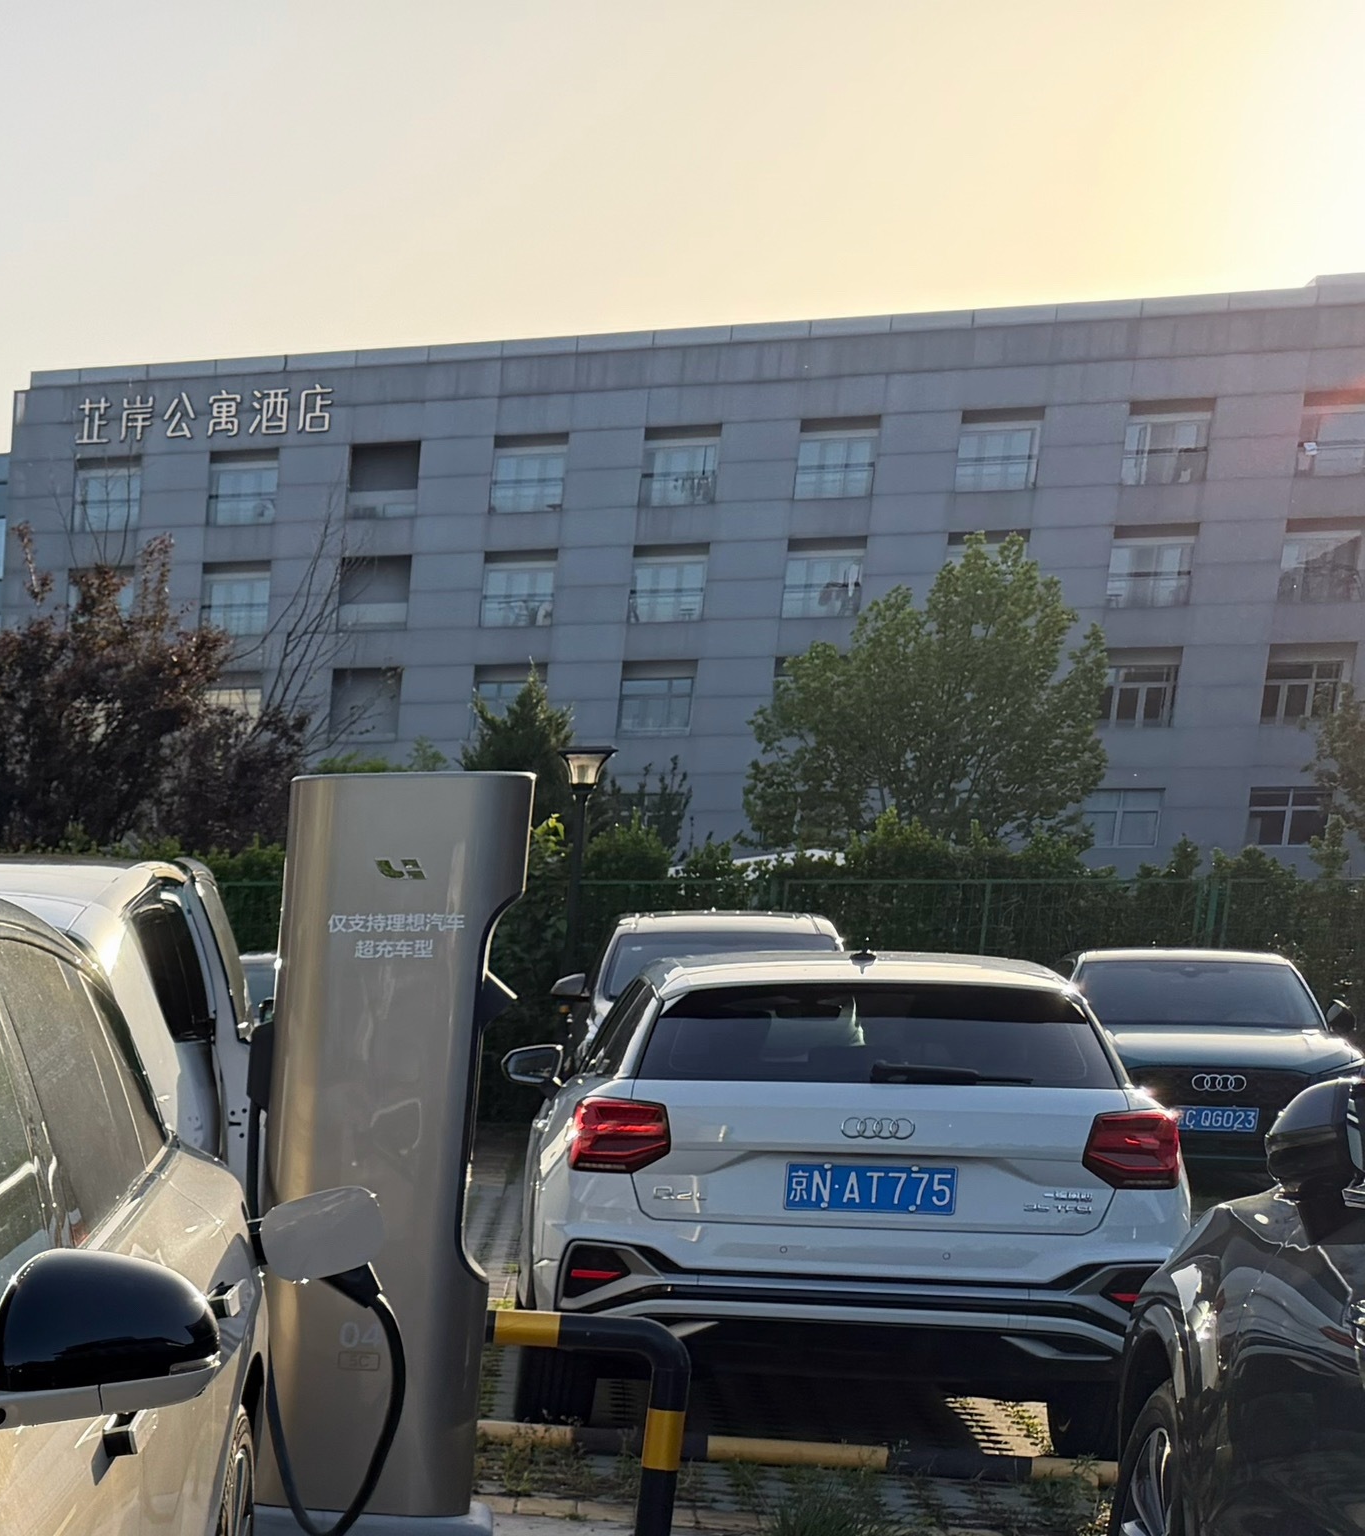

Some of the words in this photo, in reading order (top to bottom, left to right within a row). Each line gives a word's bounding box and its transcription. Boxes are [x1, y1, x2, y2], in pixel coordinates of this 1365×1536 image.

[75, 384, 333, 444] 芷岸公寓酒店
[327, 913, 465, 933] 仅支持理想汽车
[354, 939, 433, 960] 超充车型
[339, 1321, 381, 1348] 04
